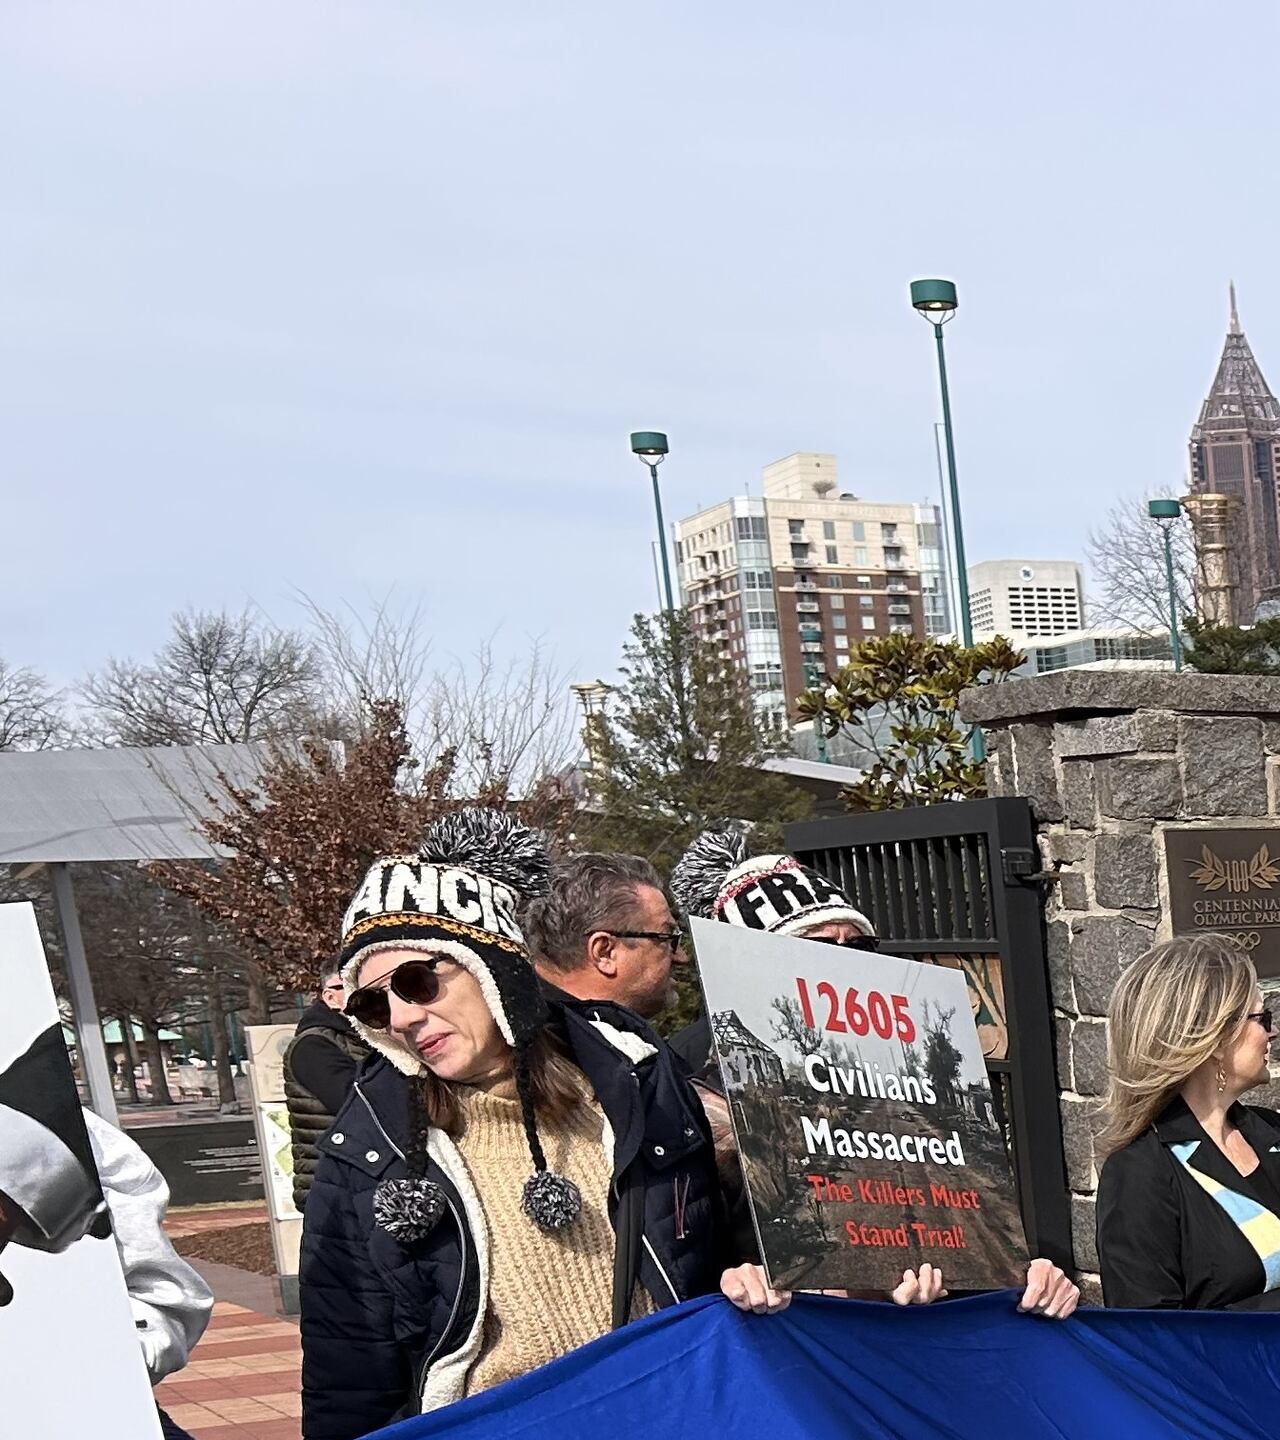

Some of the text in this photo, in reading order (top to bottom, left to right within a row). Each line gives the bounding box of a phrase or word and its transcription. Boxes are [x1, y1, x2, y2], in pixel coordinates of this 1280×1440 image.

[1193, 912, 1252, 926] OLYMPIC
[796, 977, 917, 1044] 12605
[804, 1053, 937, 1105] Civilians
[800, 1115, 966, 1166] Massacred
[806, 1174, 981, 1210] The Killers Must
[845, 1220, 968, 1249] Stand Trial!
